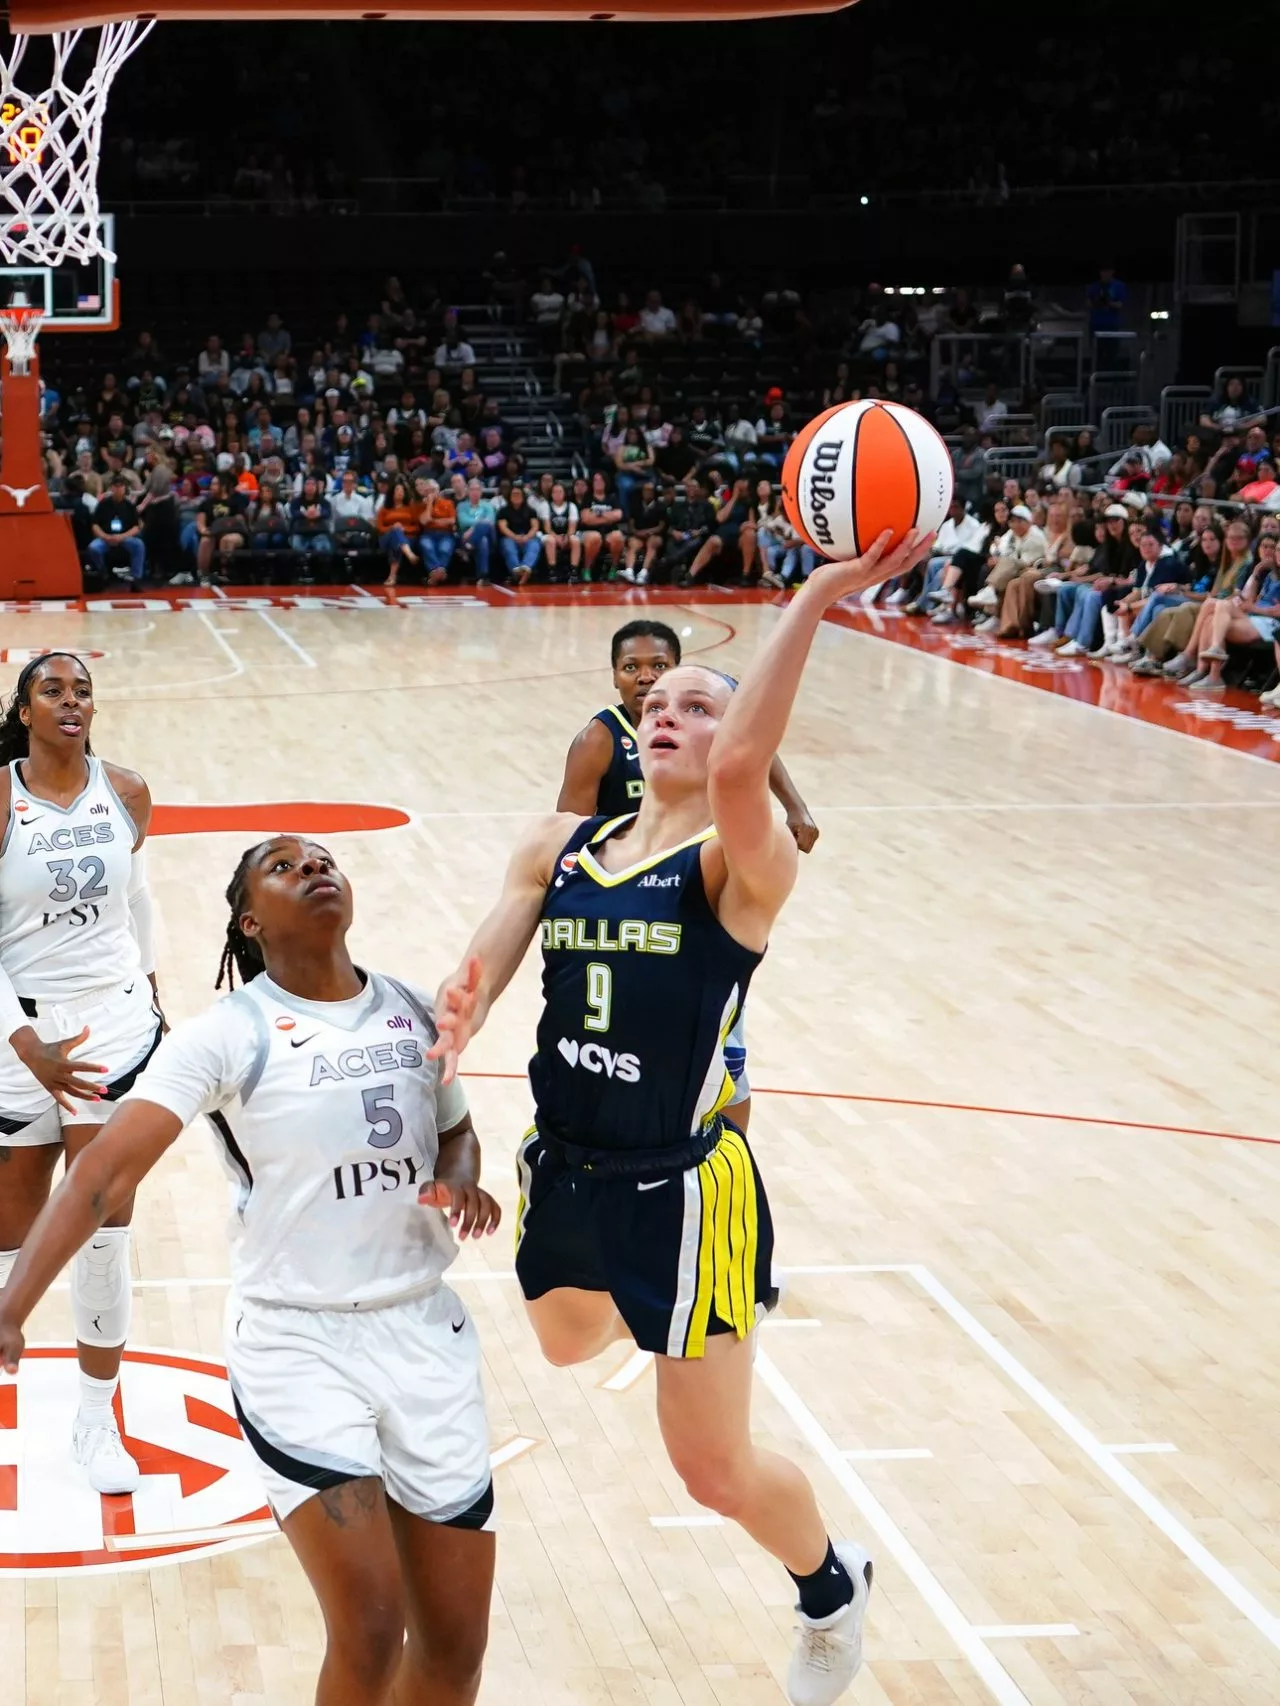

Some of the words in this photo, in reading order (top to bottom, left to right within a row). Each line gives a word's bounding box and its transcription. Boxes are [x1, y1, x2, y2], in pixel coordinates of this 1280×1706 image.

[810, 439, 844, 546] Wilson
[89, 803, 109, 816] ally
[27, 822, 115, 855] ACES
[46, 855, 108, 902] 32
[637, 873, 681, 888] Albert
[42, 903, 108, 926] ISY
[541, 918, 682, 955] DALLAS
[584, 962, 612, 1032] 9
[386, 1015, 413, 1032] ally
[309, 1039, 423, 1086] ACES
[579, 1042, 641, 1083] CVS
[361, 1084, 403, 1149] 5
[333, 1156, 425, 1200] IPSY
